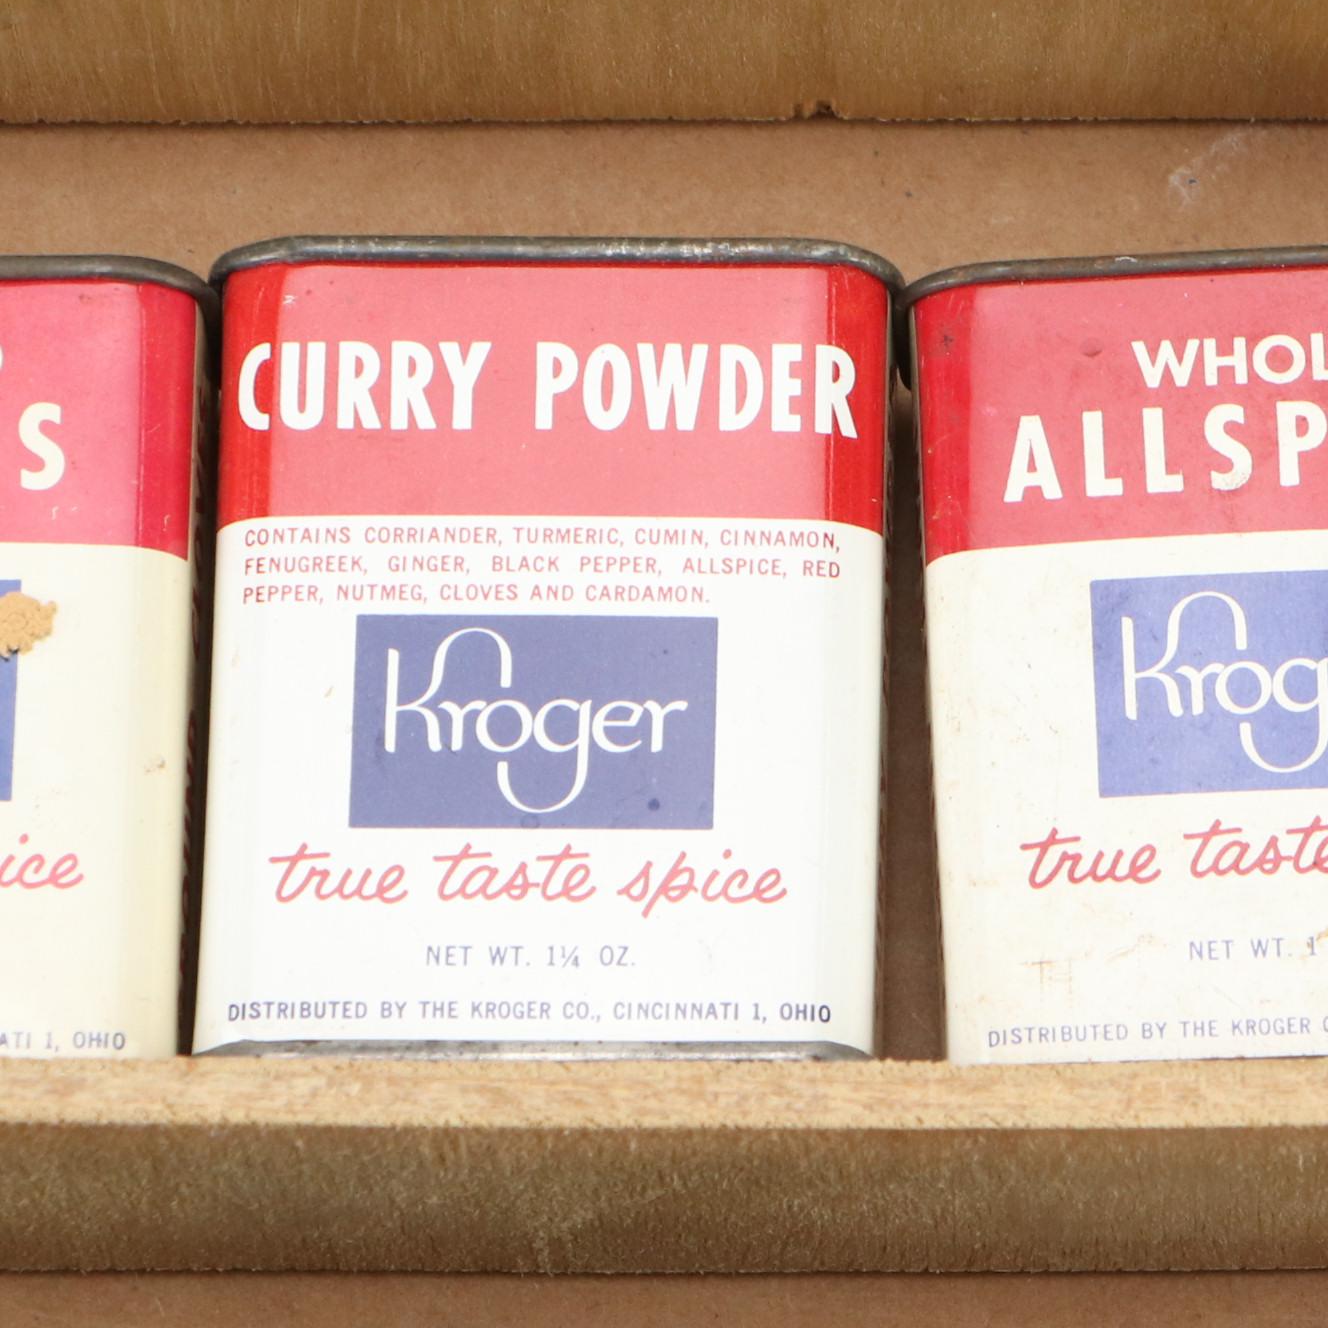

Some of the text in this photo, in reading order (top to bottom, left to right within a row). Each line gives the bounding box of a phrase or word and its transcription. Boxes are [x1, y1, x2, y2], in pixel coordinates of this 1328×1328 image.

[237, 341, 859, 439] CURRY POWDER
[244, 525, 841, 553] CONTAINS CORRIANDER, TURMERIC, CUMIN, CINNAMON,
[243, 554, 841, 579] FENUGREEK, GINGER, BLACK PEPPER, ALLSPICE, RED
[242, 583, 711, 606] PEPPER, NUTMEG, CLOVES AND CARDAMON.
[384, 627, 688, 814] Kroger
[1020, 827, 1162, 889] true
[269, 841, 788, 919] true taste spice
[426, 945, 636, 967] NET WT. OZ.
[1189, 939, 1235, 961] NET
[1251, 937, 1292, 958] WT.
[1307, 936, 1318, 956] 1
[227, 1000, 832, 1025] DISTRIBUTED BY THE KROGER CO., CINCINNATI 1, OHIO
[72, 1031, 126, 1050] OHIO
[987, 1024, 1129, 1048] DISTRIBUTED
[1140, 1020, 1167, 1040] BY
[1180, 1017, 1220, 1038] THE
[1230, 1015, 1312, 1037] KROGER
